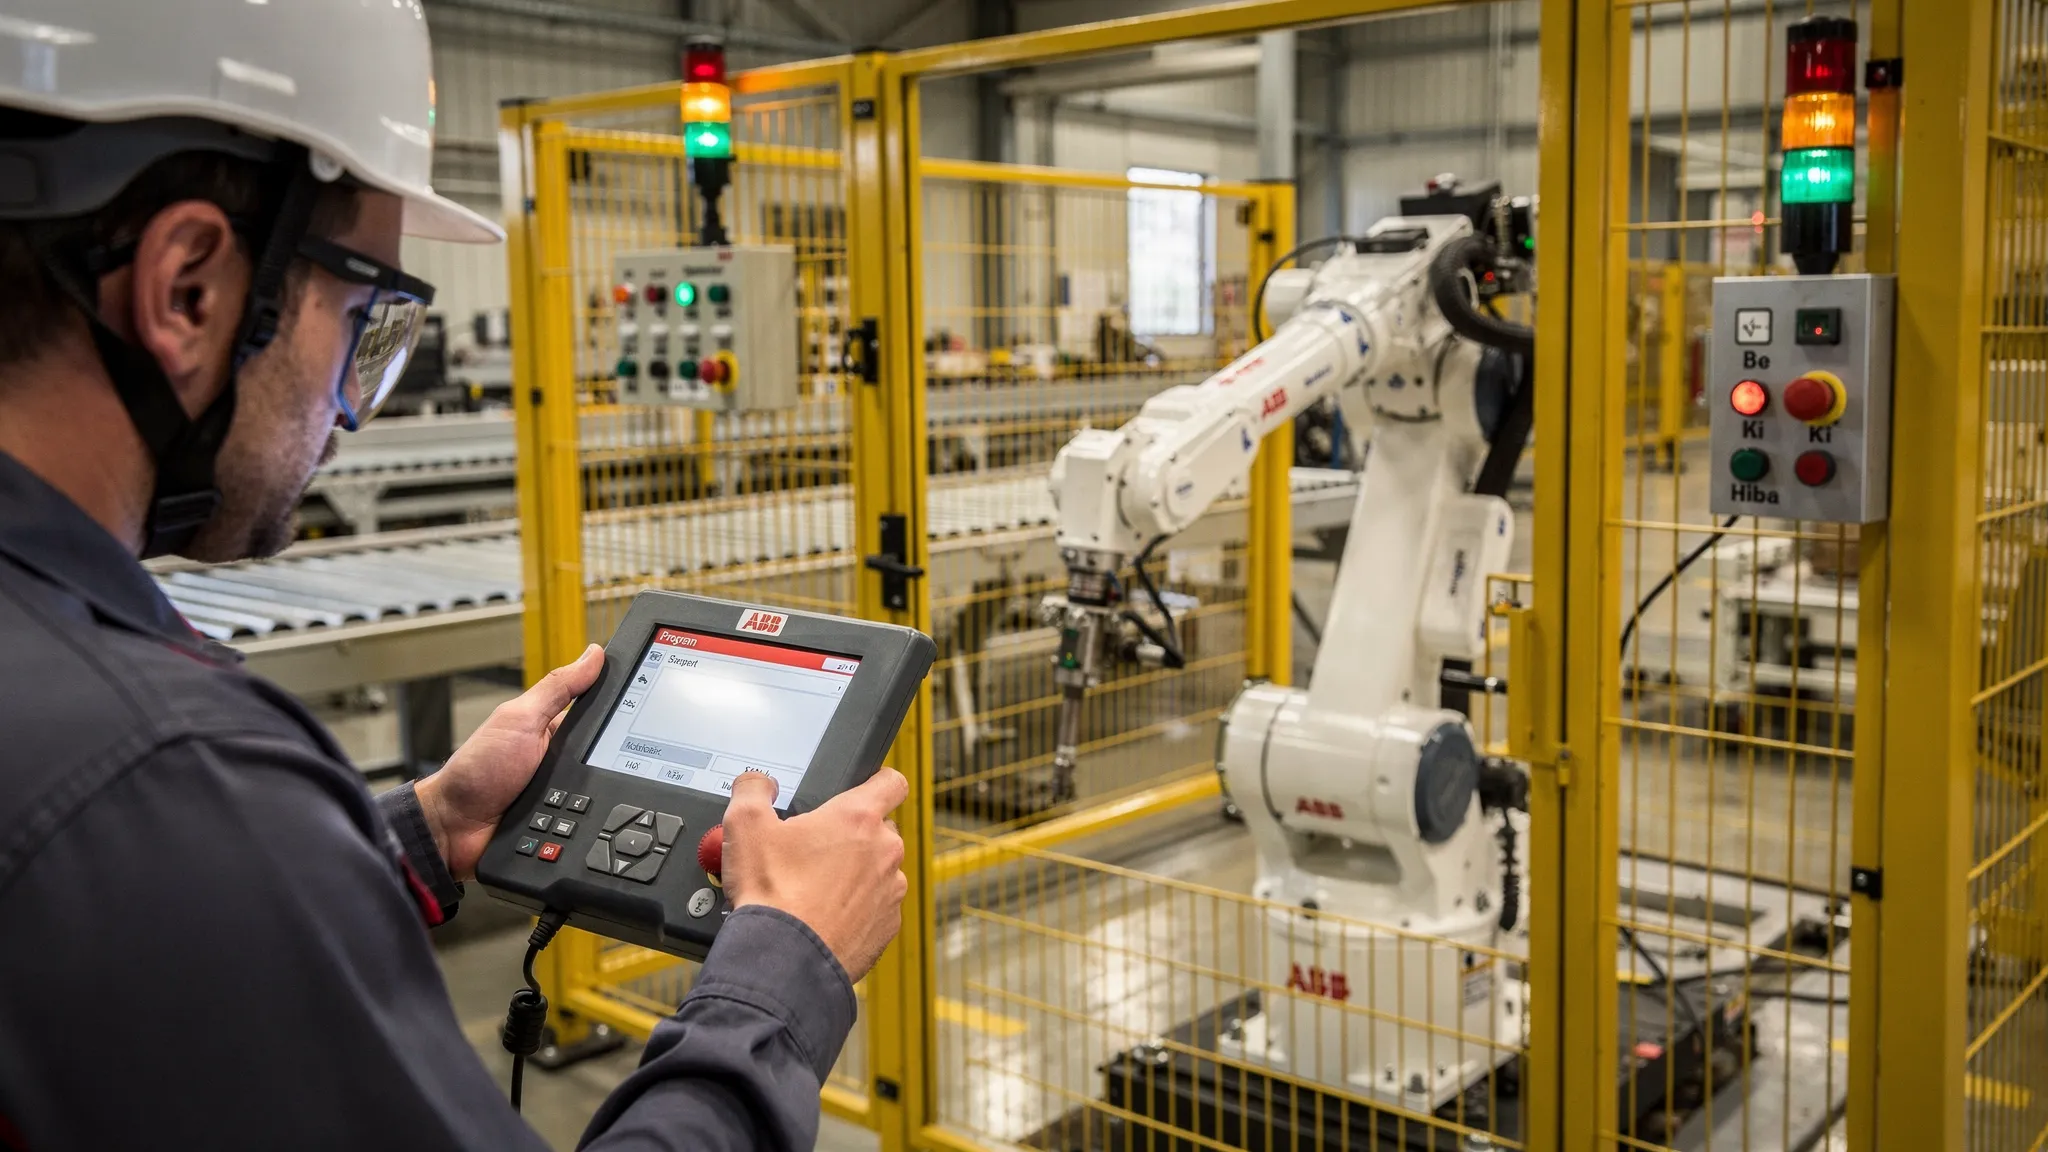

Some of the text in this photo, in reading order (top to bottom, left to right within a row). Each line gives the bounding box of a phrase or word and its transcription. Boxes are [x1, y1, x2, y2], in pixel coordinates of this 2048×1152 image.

[1743, 350, 1771, 370] Be
[1742, 420, 1765, 440] Ki
[1731, 484, 1780, 505] Hiba
[741, 612, 782, 633] ABB
[1296, 797, 1344, 820] ABB
